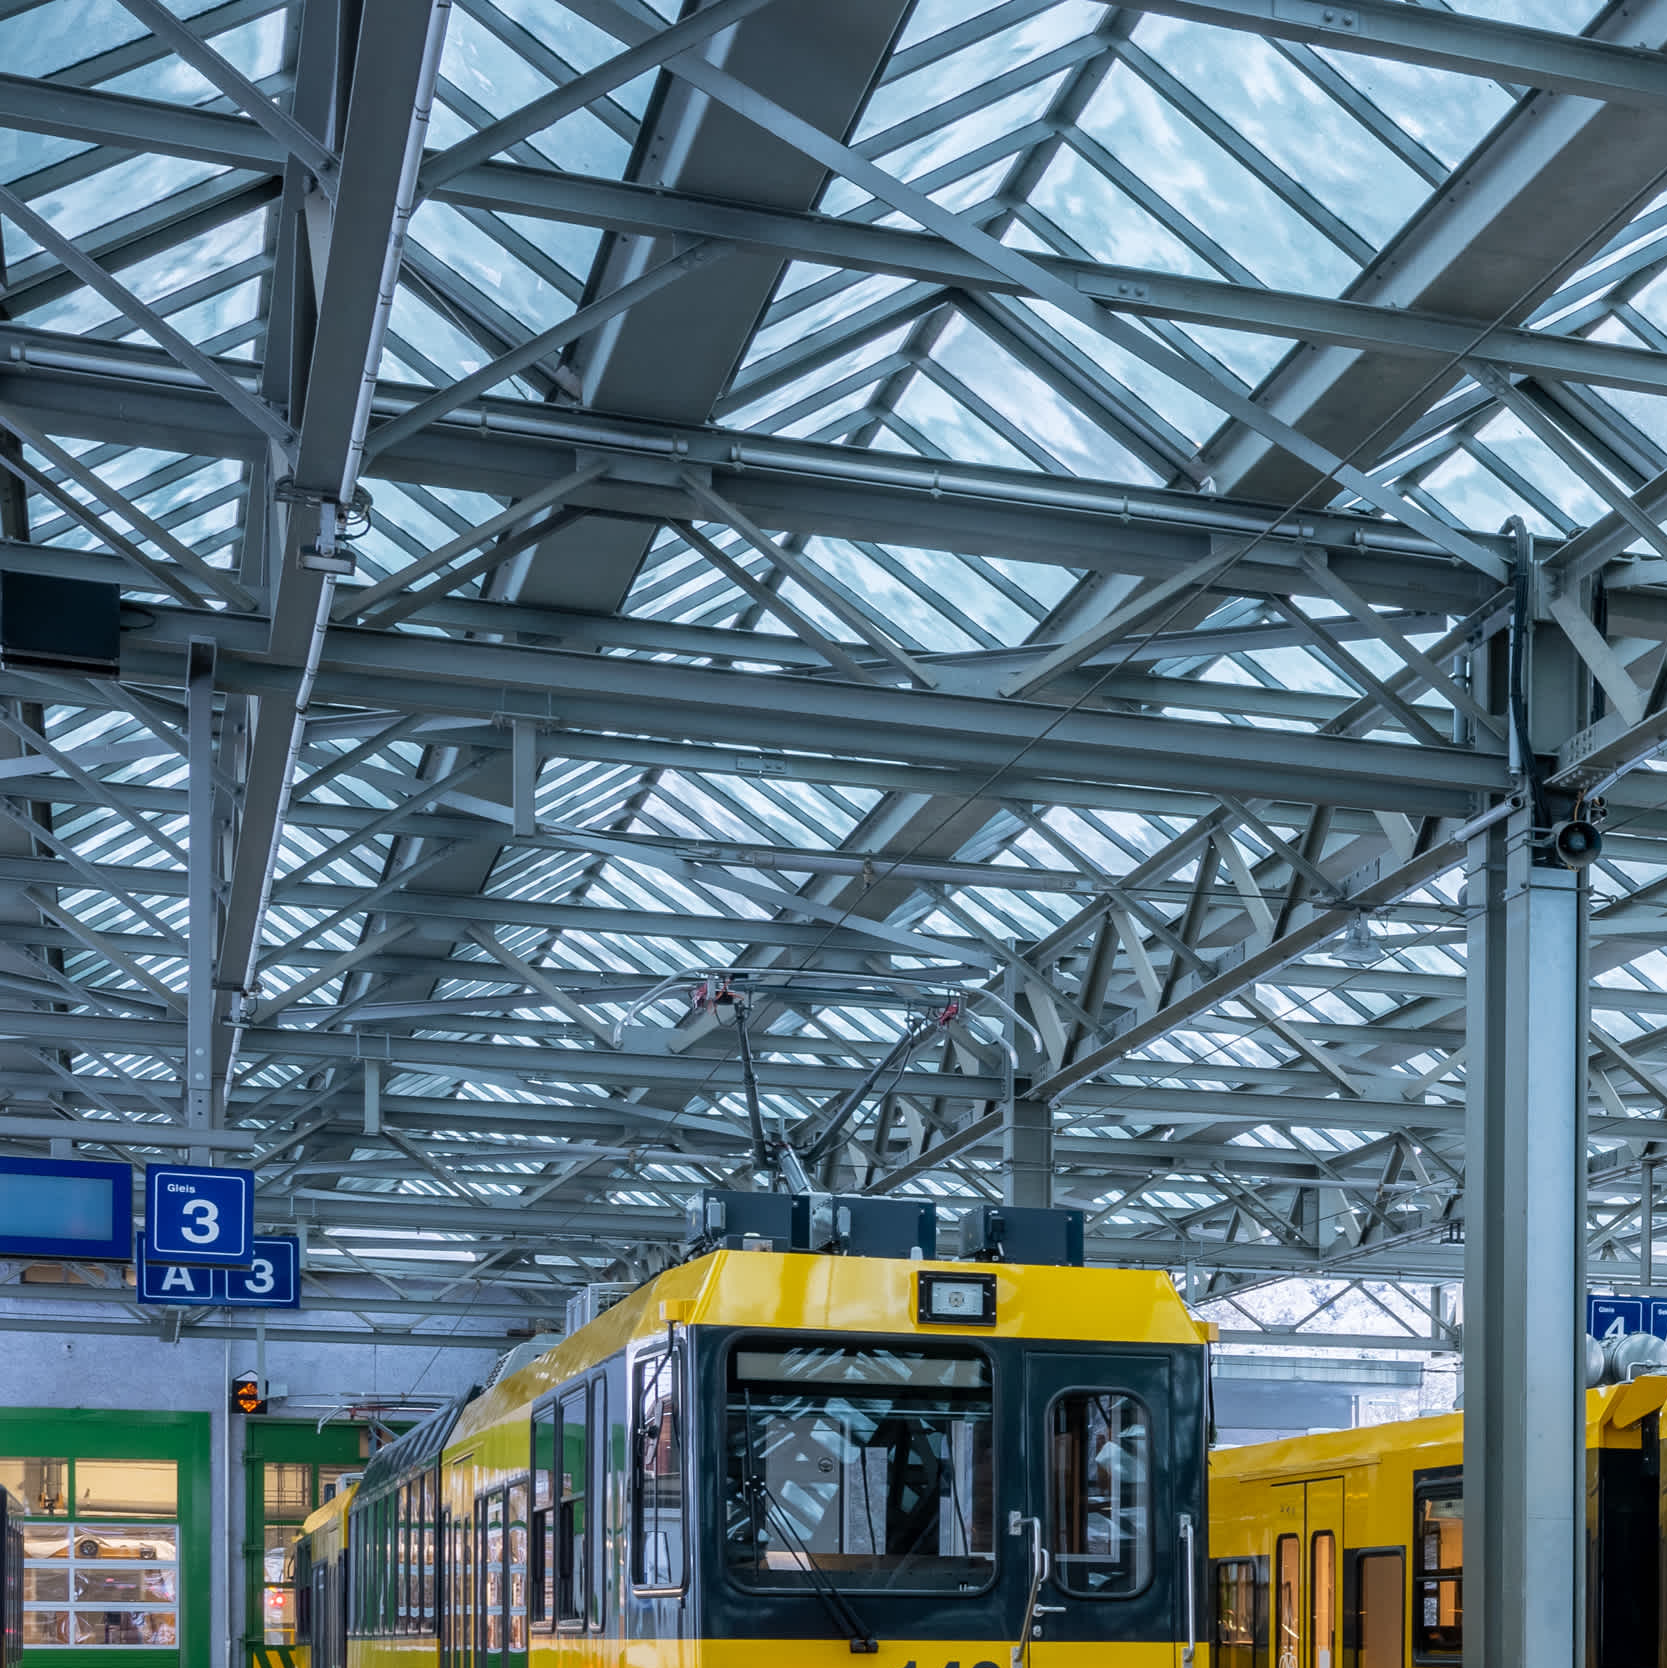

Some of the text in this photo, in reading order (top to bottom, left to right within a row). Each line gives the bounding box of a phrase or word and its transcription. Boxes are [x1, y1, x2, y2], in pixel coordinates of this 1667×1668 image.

[167, 1183, 196, 1194] Gleis
[181, 1199, 220, 1244] 3
[161, 1266, 195, 1291] A
[245, 1258, 275, 1293] 3
[1603, 1316, 1627, 1340] 4
